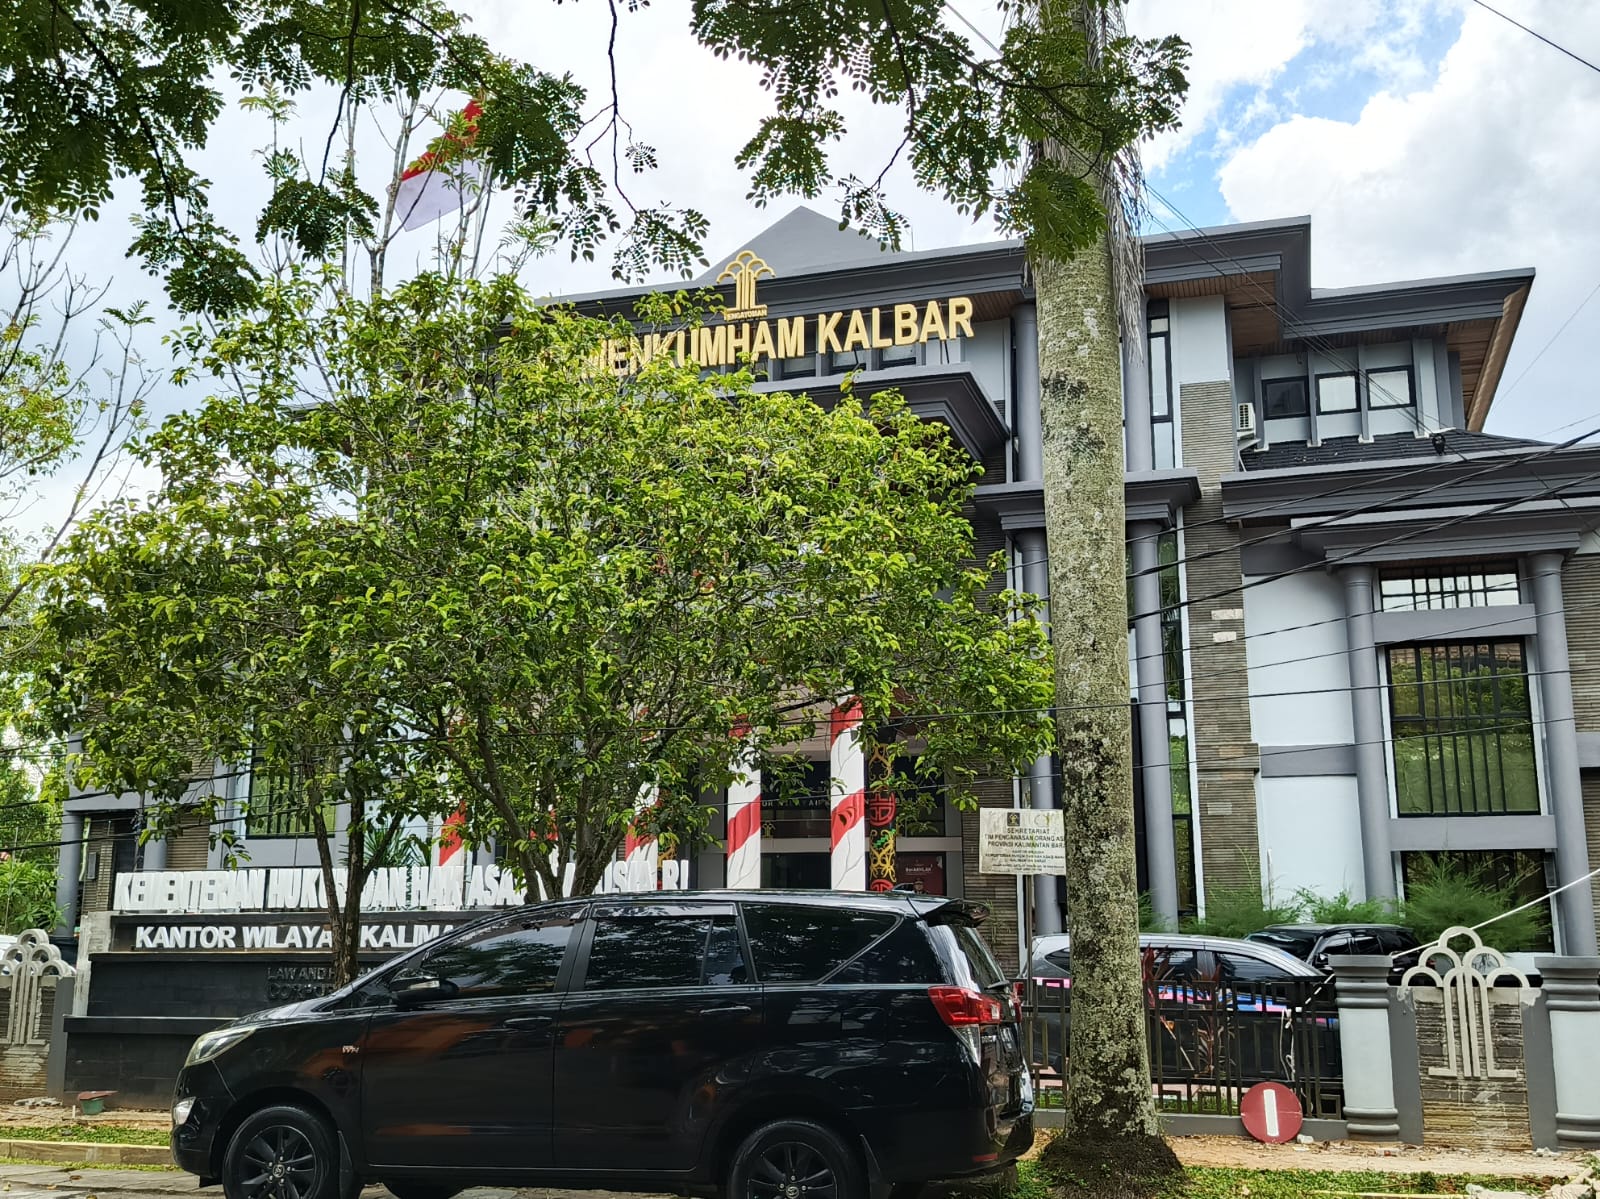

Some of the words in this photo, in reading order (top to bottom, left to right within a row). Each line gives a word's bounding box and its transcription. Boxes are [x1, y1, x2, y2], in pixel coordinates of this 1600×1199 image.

[818, 297, 975, 354] KALBAR
[468, 864, 529, 905] ASA
[662, 859, 689, 890] RI
[135, 926, 236, 949] KANTOR
[242, 925, 334, 949] WILAYA
